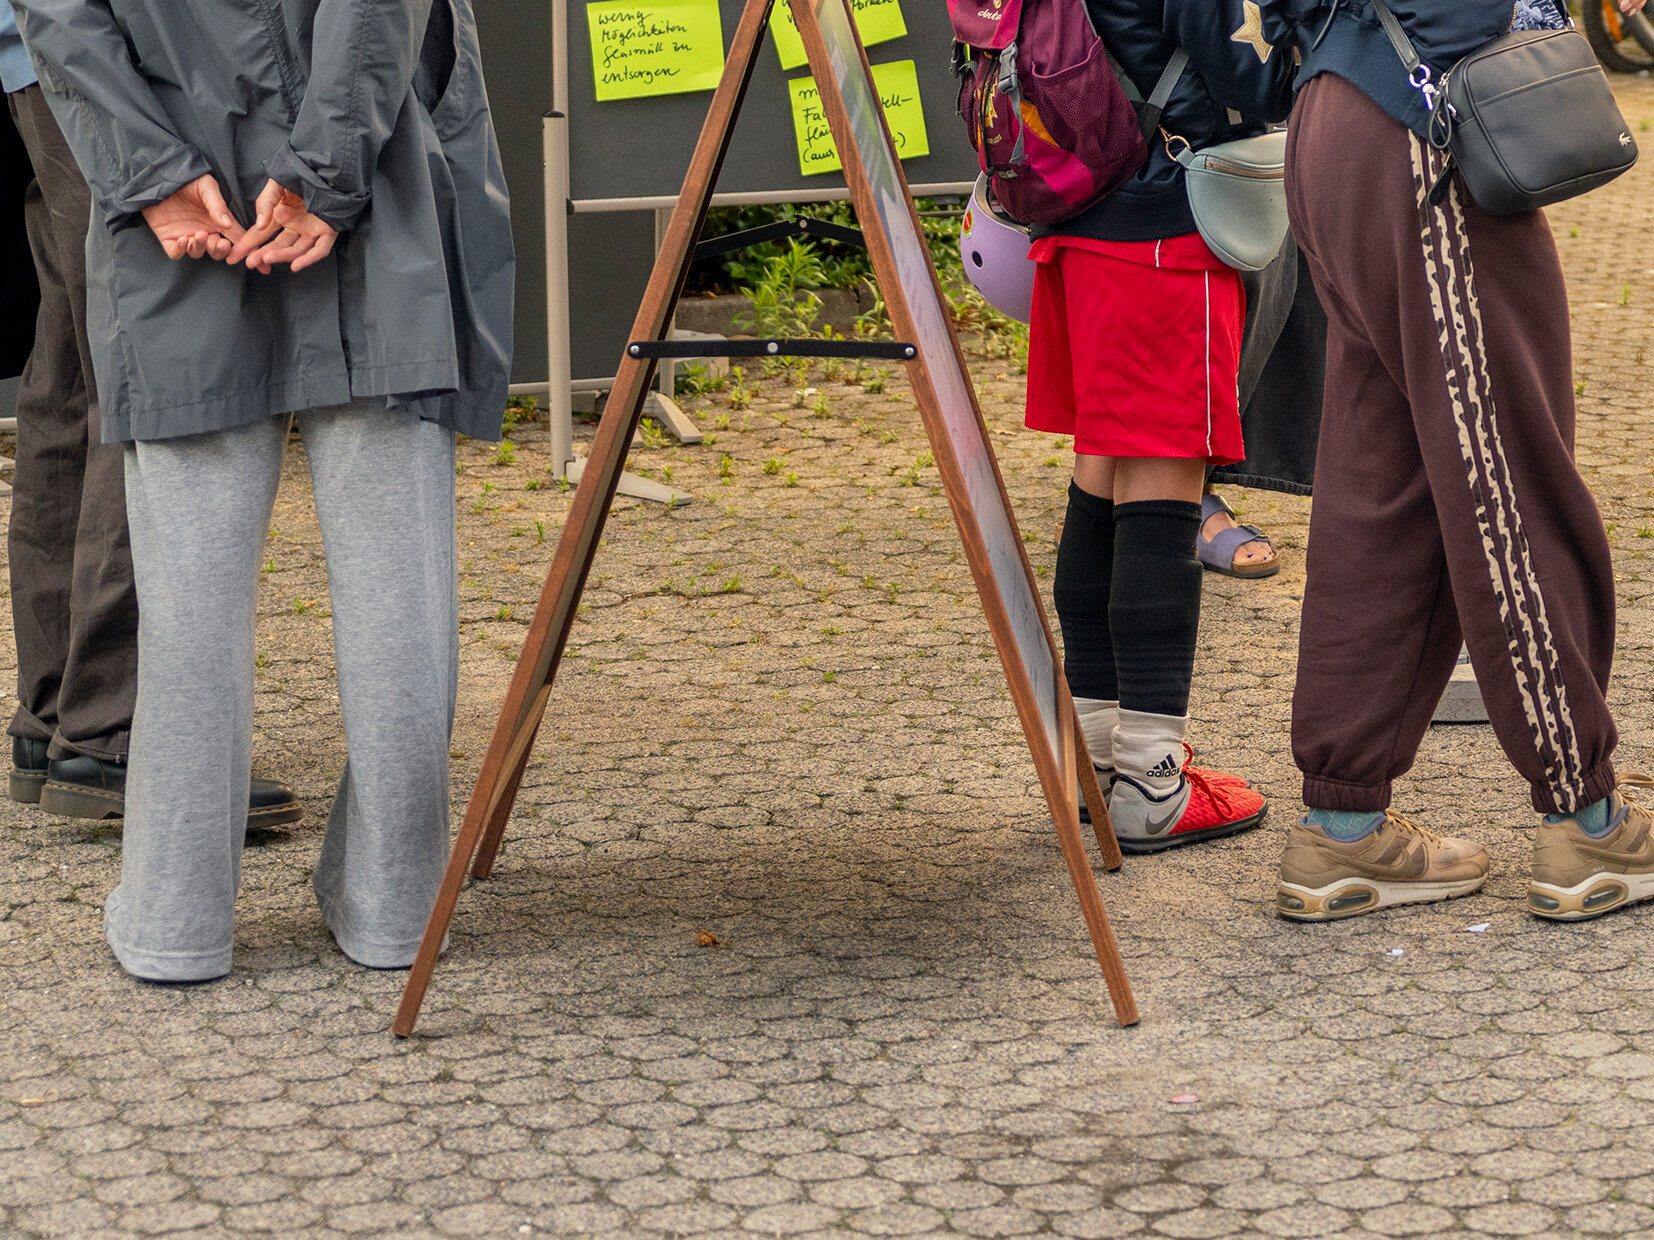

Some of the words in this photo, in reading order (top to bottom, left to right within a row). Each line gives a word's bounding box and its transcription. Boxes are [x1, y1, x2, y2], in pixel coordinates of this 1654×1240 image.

[978, 9, 1001, 21] deute
[601, 65, 681, 85] entsorgen
[1146, 768, 1180, 778] adidas
